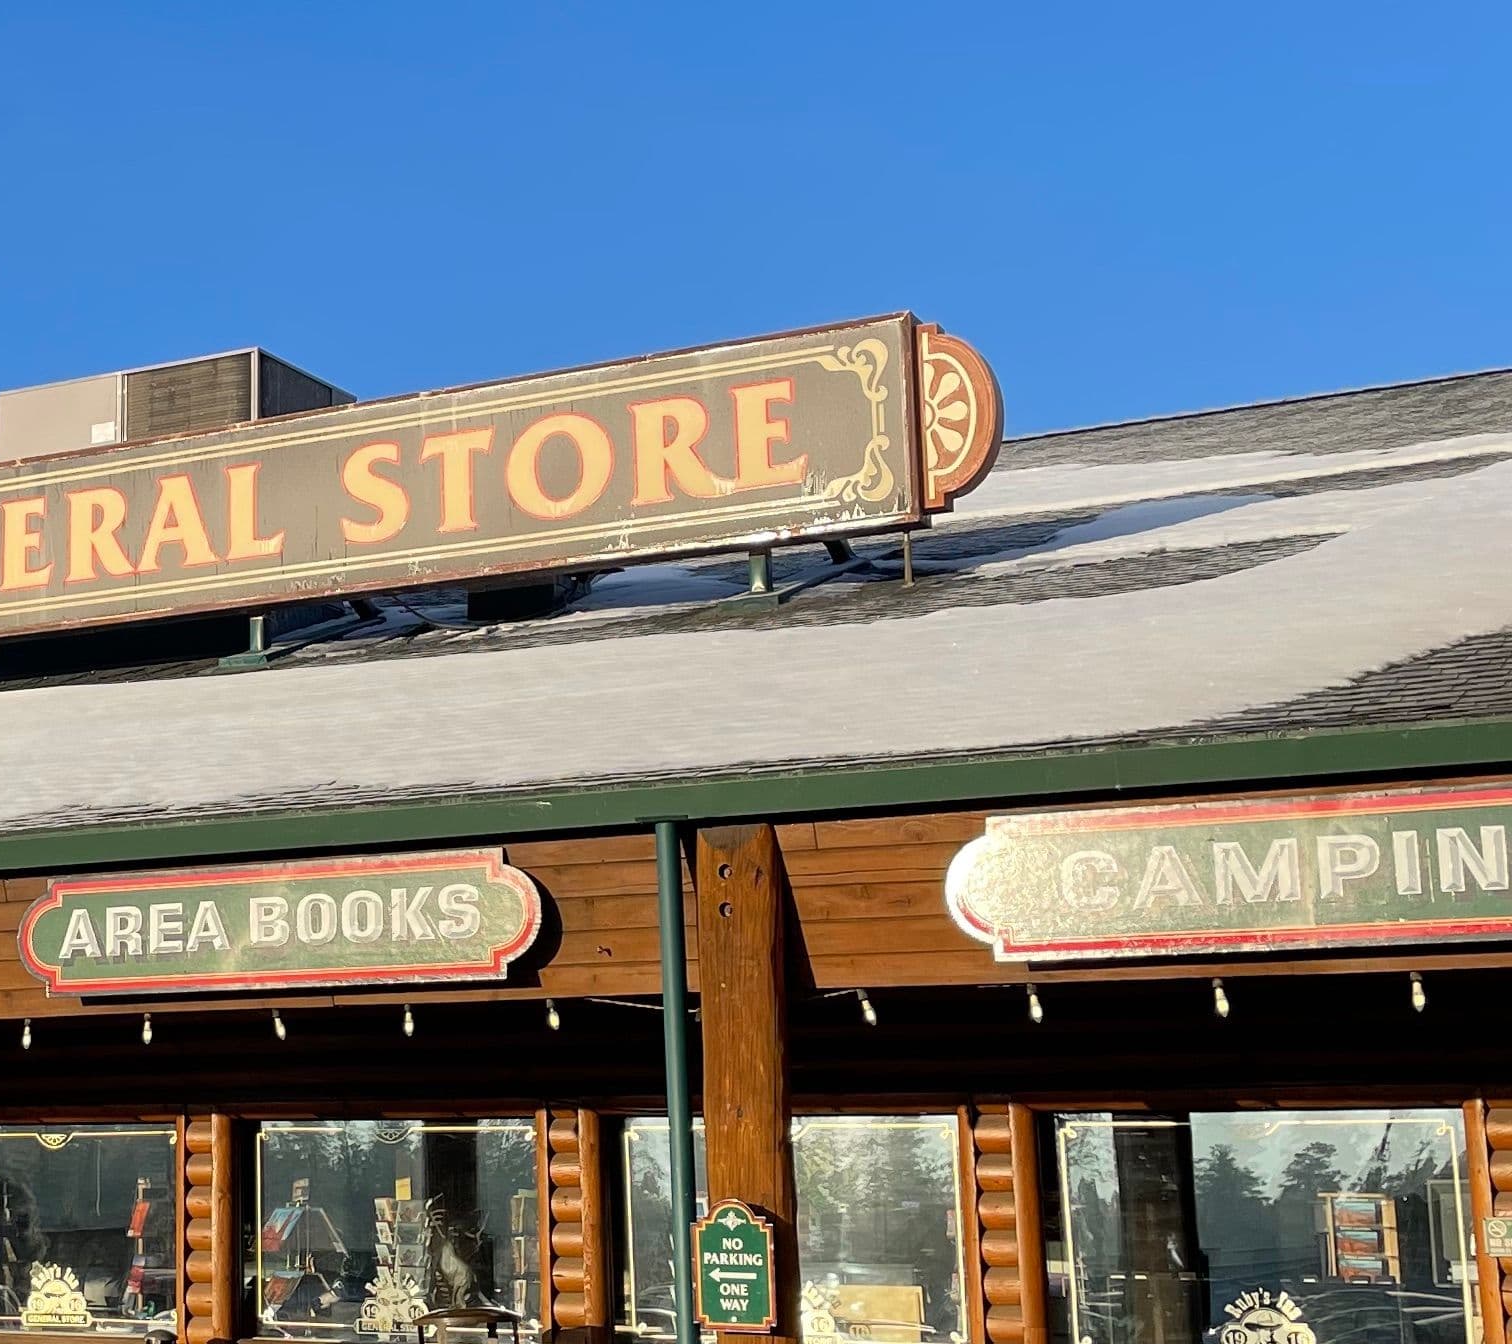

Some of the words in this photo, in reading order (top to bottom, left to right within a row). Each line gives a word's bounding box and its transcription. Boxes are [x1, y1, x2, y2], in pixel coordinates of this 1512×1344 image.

[338, 377, 809, 545] STORE
[1060, 824, 1510, 912] CAMPIN
[59, 900, 231, 960] AREA
[249, 883, 480, 948] BOOKS
[722, 1237, 744, 1251] NO
[703, 1252, 763, 1266] PARKING
[719, 1283, 749, 1296] ONE
[719, 1298, 749, 1312] WAY
[1224, 1287, 1271, 1319] Ruby's
